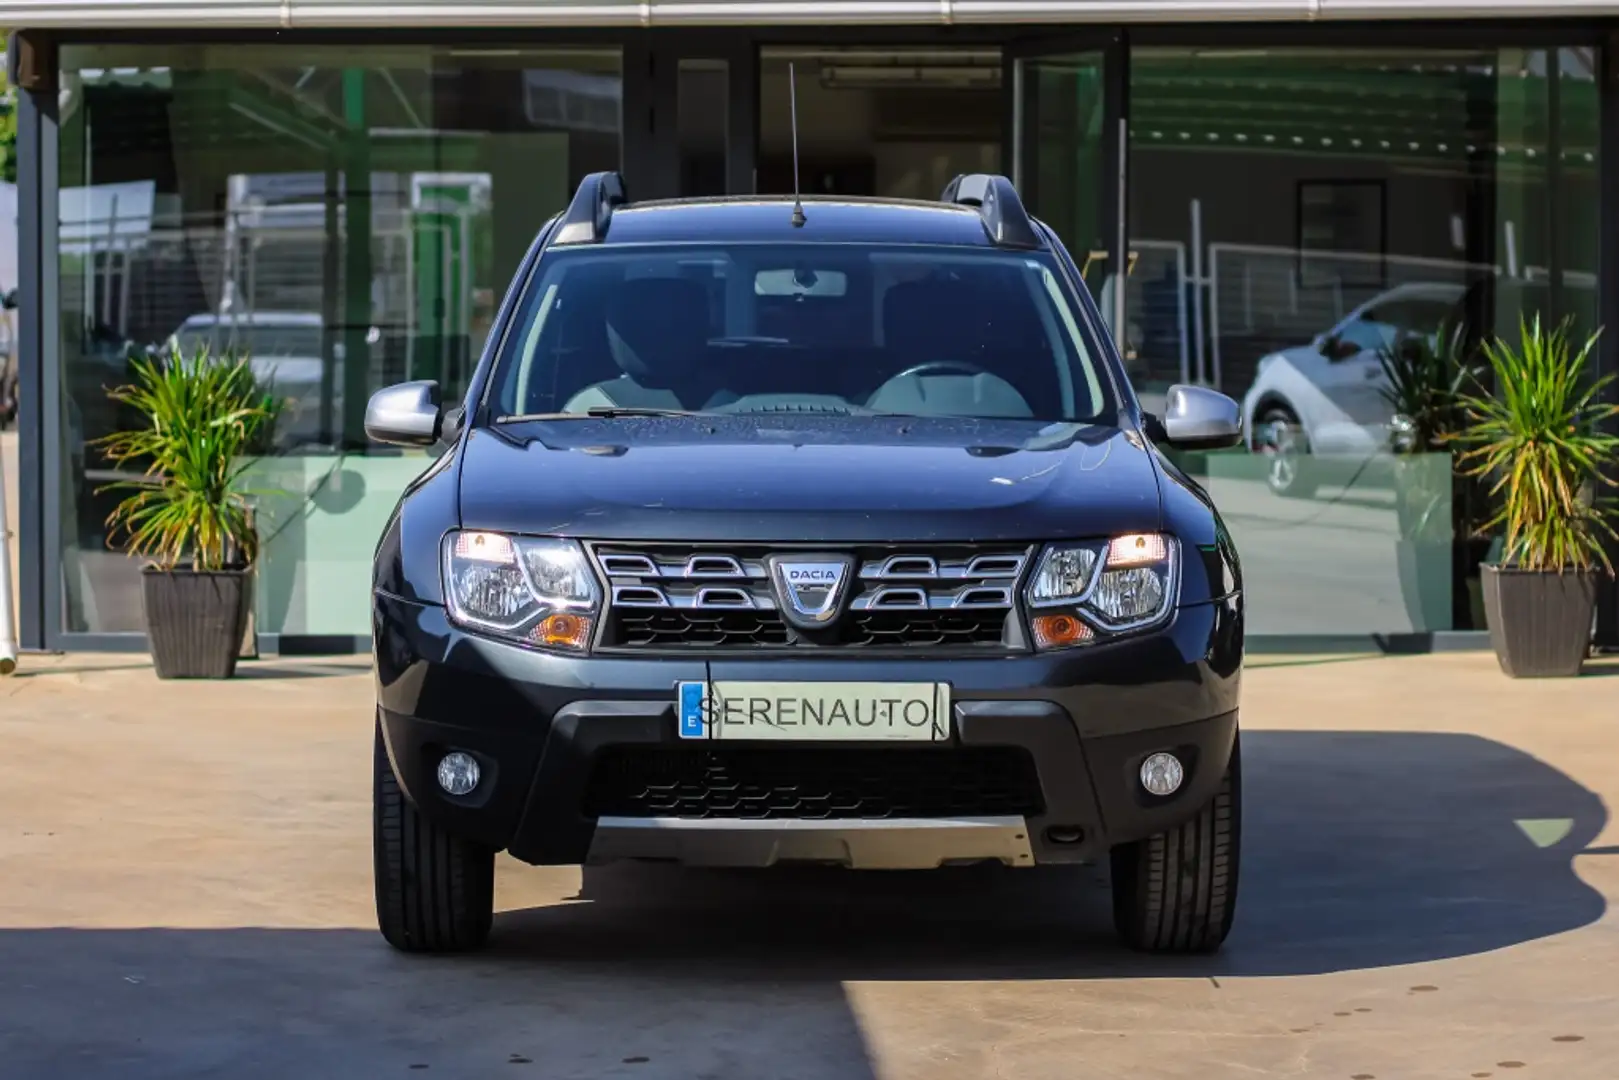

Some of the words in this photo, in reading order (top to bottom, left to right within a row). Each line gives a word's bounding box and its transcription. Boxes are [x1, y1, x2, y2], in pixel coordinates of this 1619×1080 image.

[790, 570, 836, 580] DACIA
[698, 697, 930, 727] SERENAUTO
[687, 715, 697, 727] E
